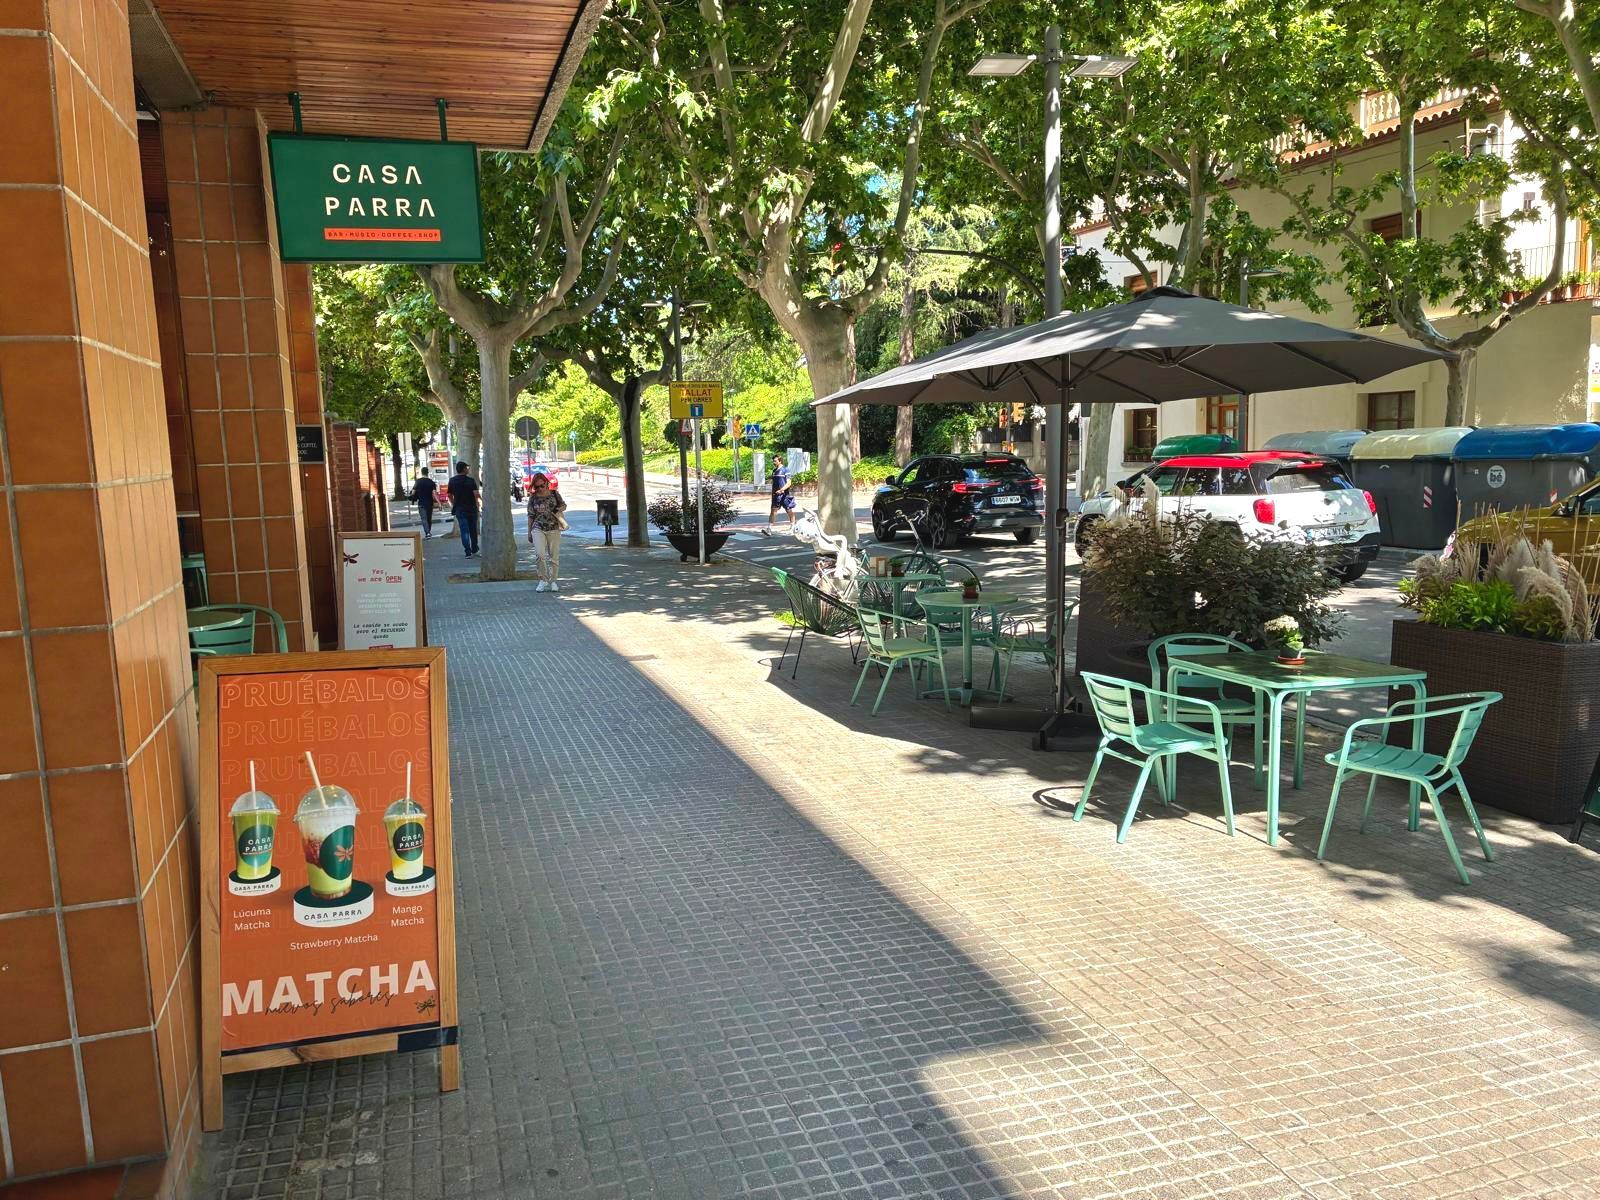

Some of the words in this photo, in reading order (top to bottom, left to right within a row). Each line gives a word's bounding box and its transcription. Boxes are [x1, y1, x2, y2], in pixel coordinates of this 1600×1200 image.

[332, 162, 422, 186] CASA
[324, 196, 436, 218] PARRA
[680, 388, 713, 396] TALLAT
[221, 673, 430, 709] PRUÉBALOS
[221, 709, 430, 747] PRUÉBALOS
[304, 913, 328, 921] CASA
[333, 909, 362, 918] PARRA
[392, 904, 423, 916] Mango
[234, 920, 270, 932] Matcha
[391, 916, 424, 928] Matcha
[290, 937, 342, 951] Strawberry
[344, 932, 378, 945] Matcha
[222, 959, 437, 1017] MATCHA
